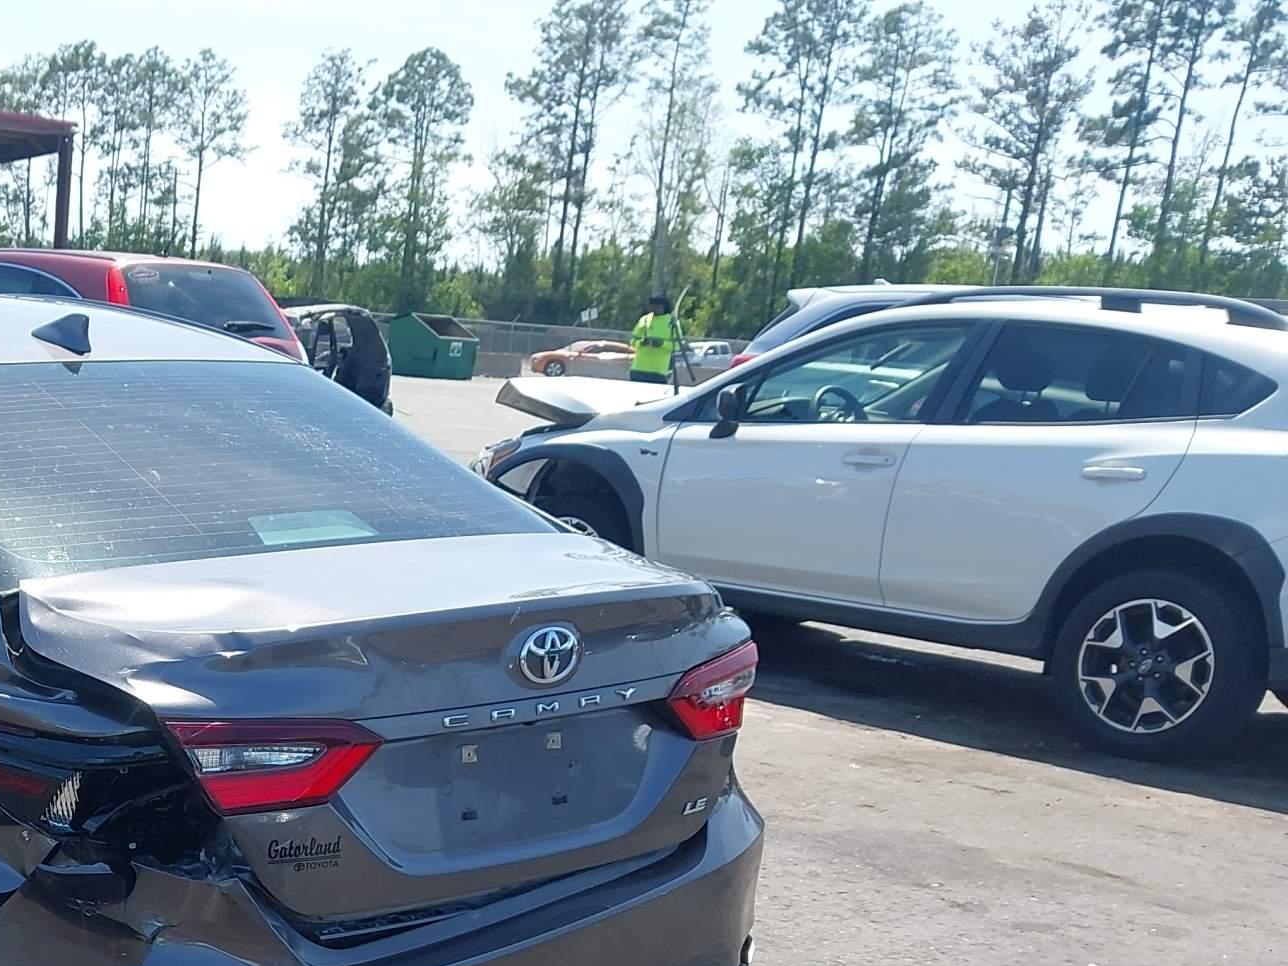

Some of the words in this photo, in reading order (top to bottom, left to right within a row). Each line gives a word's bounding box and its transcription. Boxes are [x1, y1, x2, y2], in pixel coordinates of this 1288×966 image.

[443, 687, 637, 728] CAMRY
[682, 797, 708, 816] LE
[267, 835, 342, 860] Gatorland
[305, 860, 339, 871] TOYOTA
